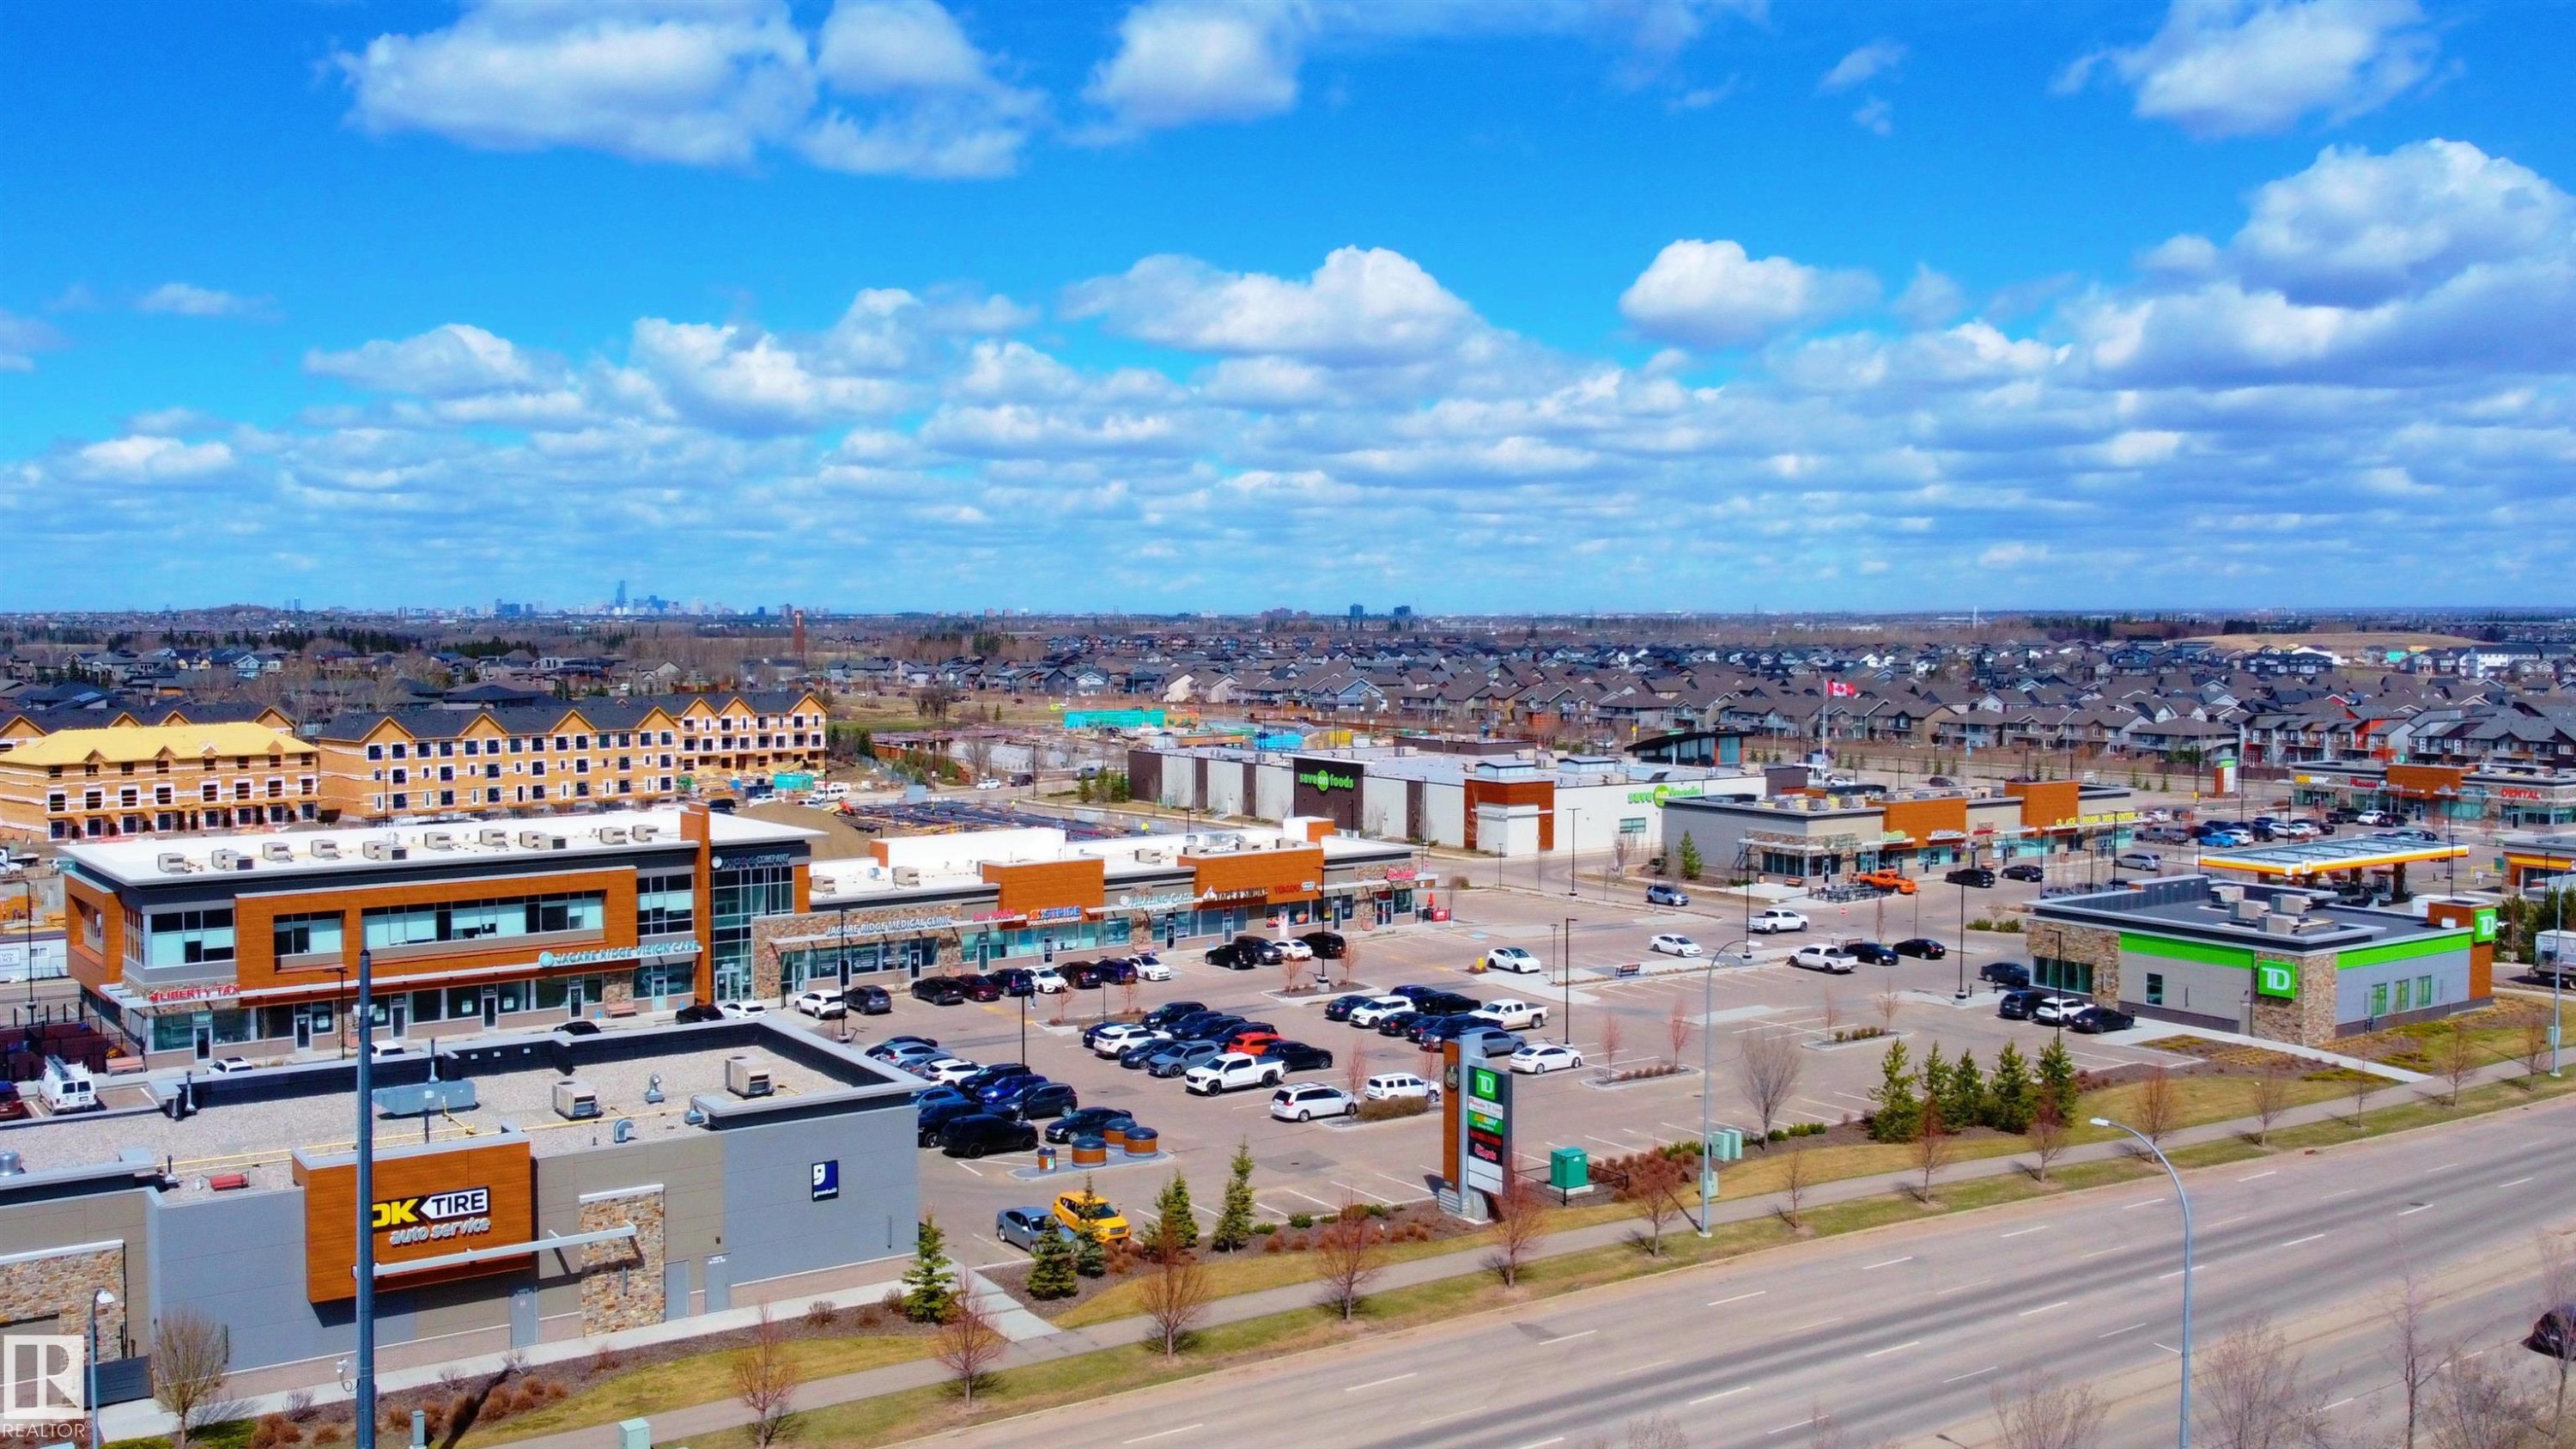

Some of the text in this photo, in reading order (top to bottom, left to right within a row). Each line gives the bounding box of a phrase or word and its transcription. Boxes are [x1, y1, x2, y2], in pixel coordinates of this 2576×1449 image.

[1299, 773, 1354, 788] save on foods
[2501, 786, 2541, 800] DENTAL
[1042, 906, 1081, 920] STRIDE
[860, 921, 886, 934] RIDGE
[888, 917, 925, 931] MEDICAL
[927, 915, 952, 928] CLINIC
[2479, 916, 2495, 936] TD
[600, 947, 633, 961] RIDGE
[636, 945, 671, 958] VISION
[674, 941, 700, 953] CARE
[2261, 966, 2290, 990] TD
[160, 984, 241, 1002] LIBERTY TAX
[1478, 1075, 1493, 1093] TD
[431, 1192, 485, 1216] TIRE
[389, 1217, 491, 1245] auto service
